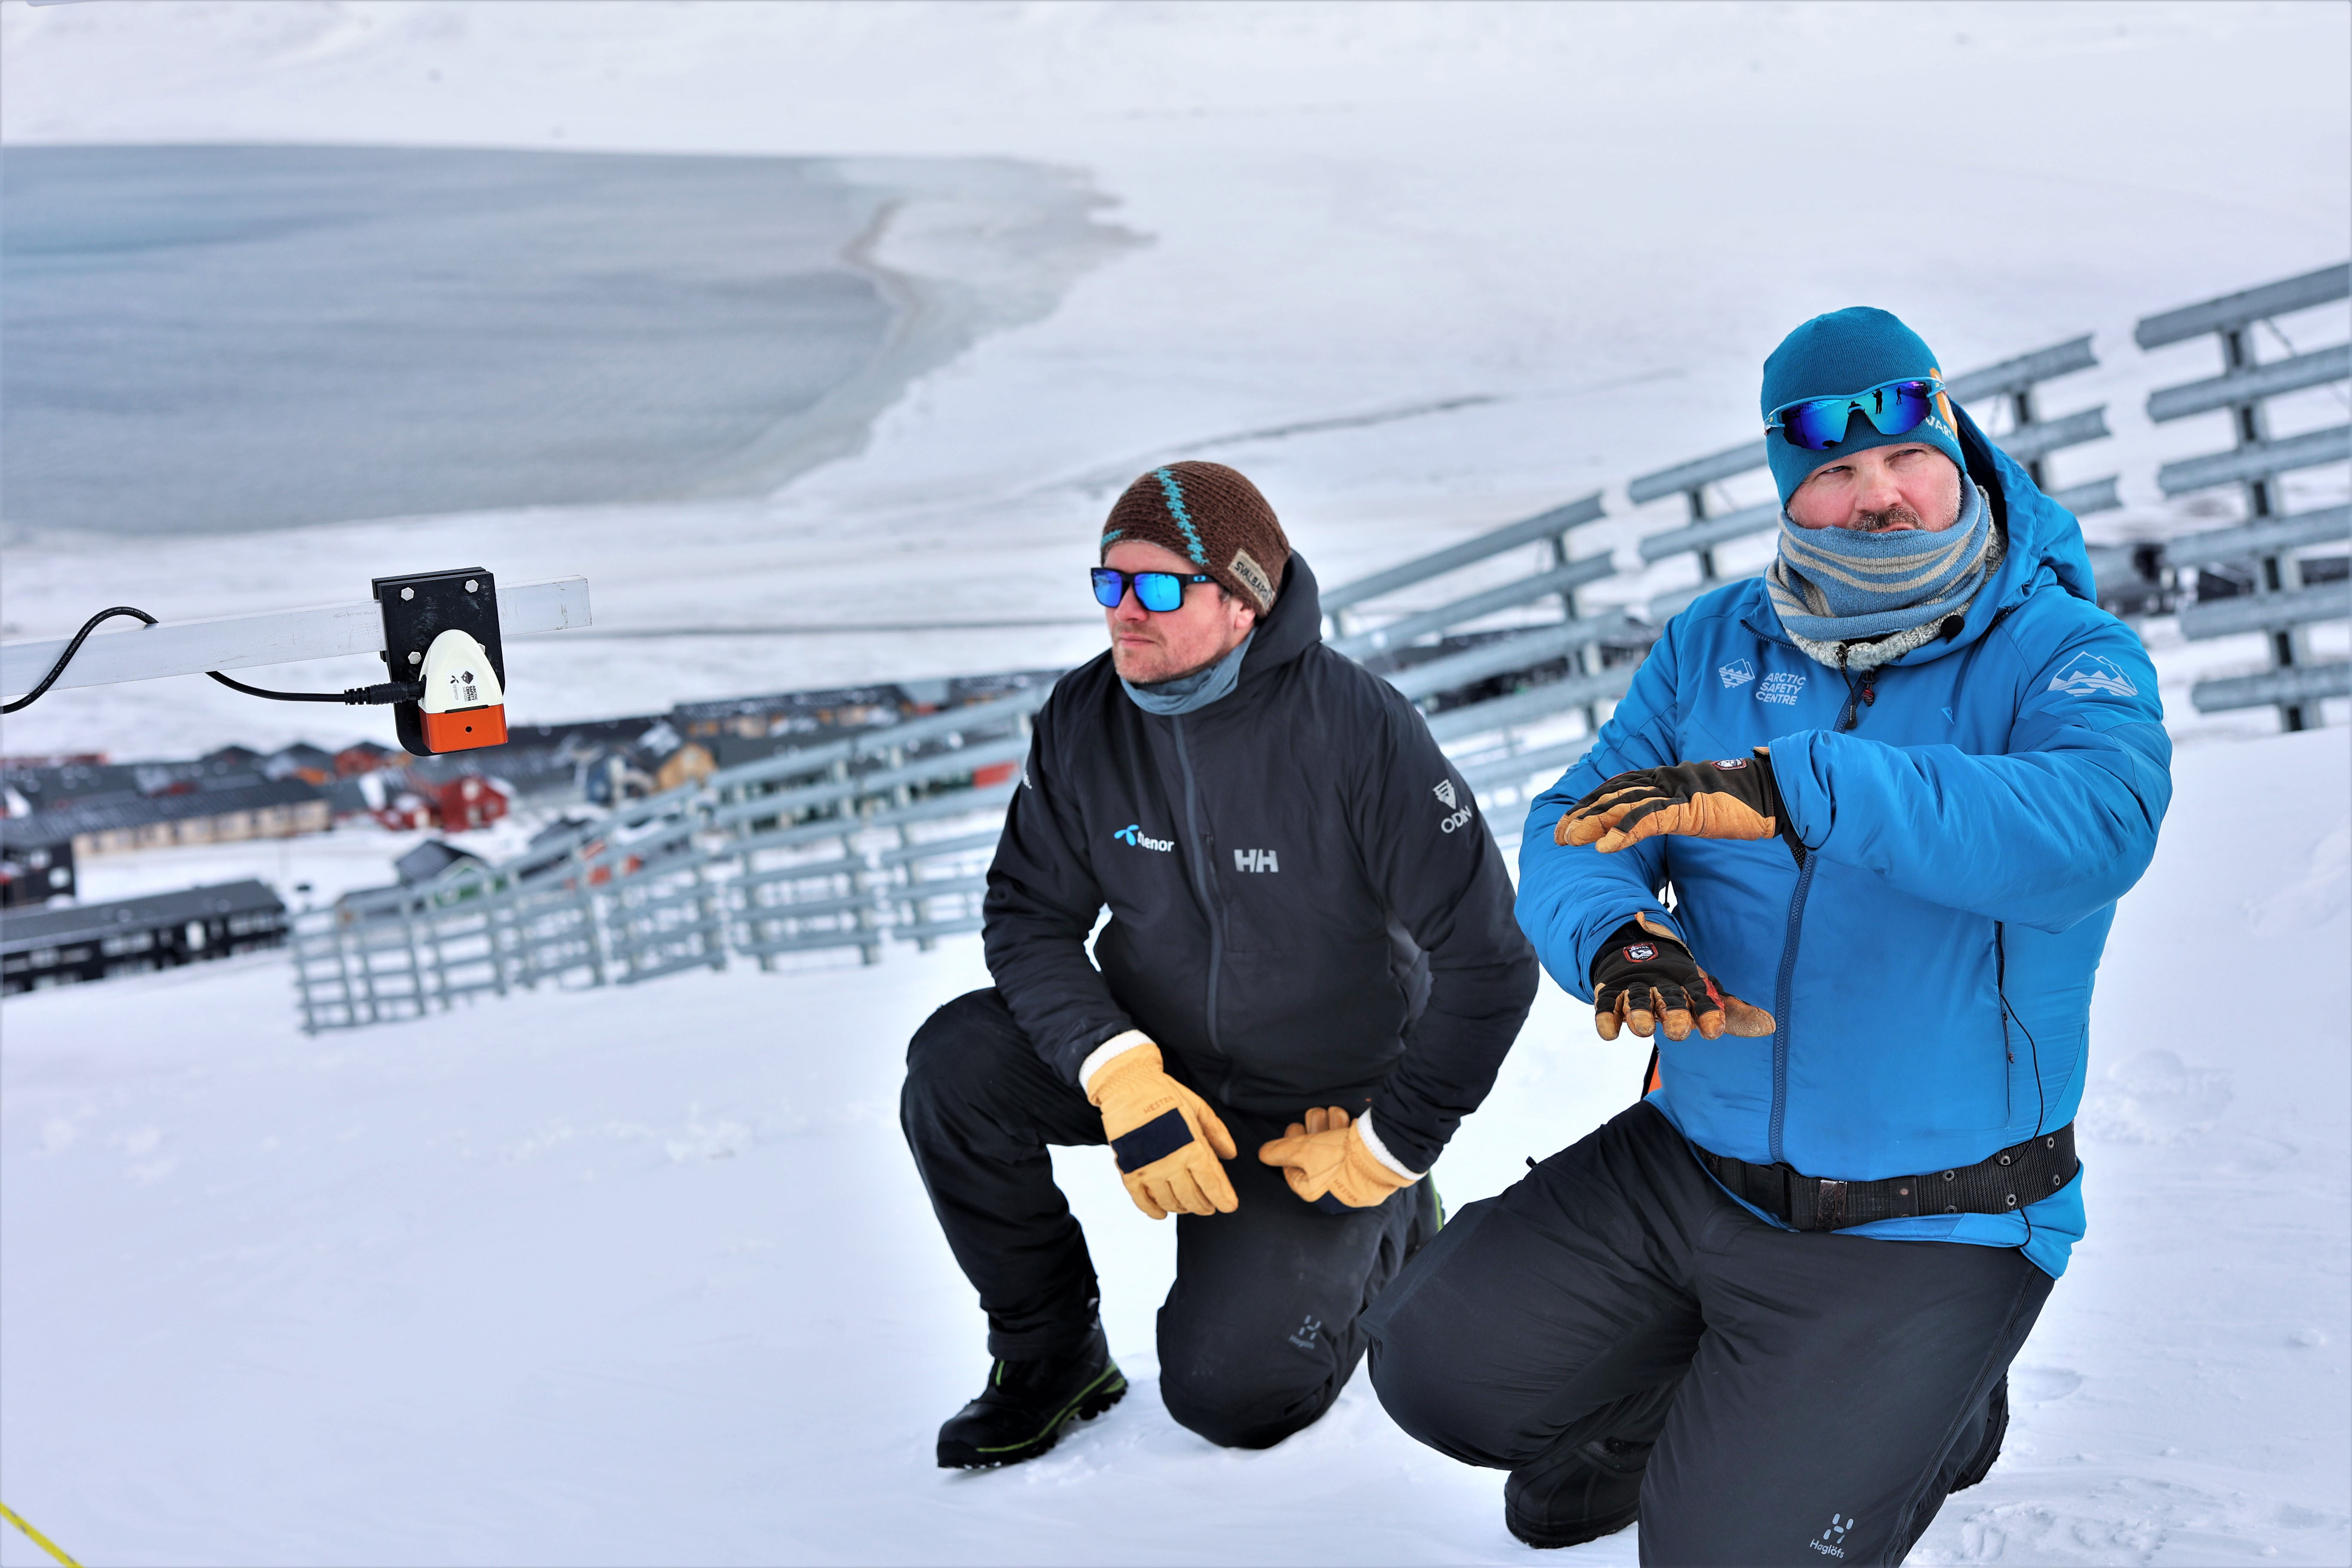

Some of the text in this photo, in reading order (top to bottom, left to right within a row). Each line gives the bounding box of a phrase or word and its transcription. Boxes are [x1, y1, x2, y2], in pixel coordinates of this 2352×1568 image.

[1764, 672, 1807, 686] ARCTIC
[1759, 681, 1803, 695] SAFETY
[1755, 691, 1798, 706] CENTRE
[1137, 830, 1175, 852] tlenor
[1142, 1095, 1175, 1115] HESTRA
[1809, 1539, 1845, 1559] Haglöfs
